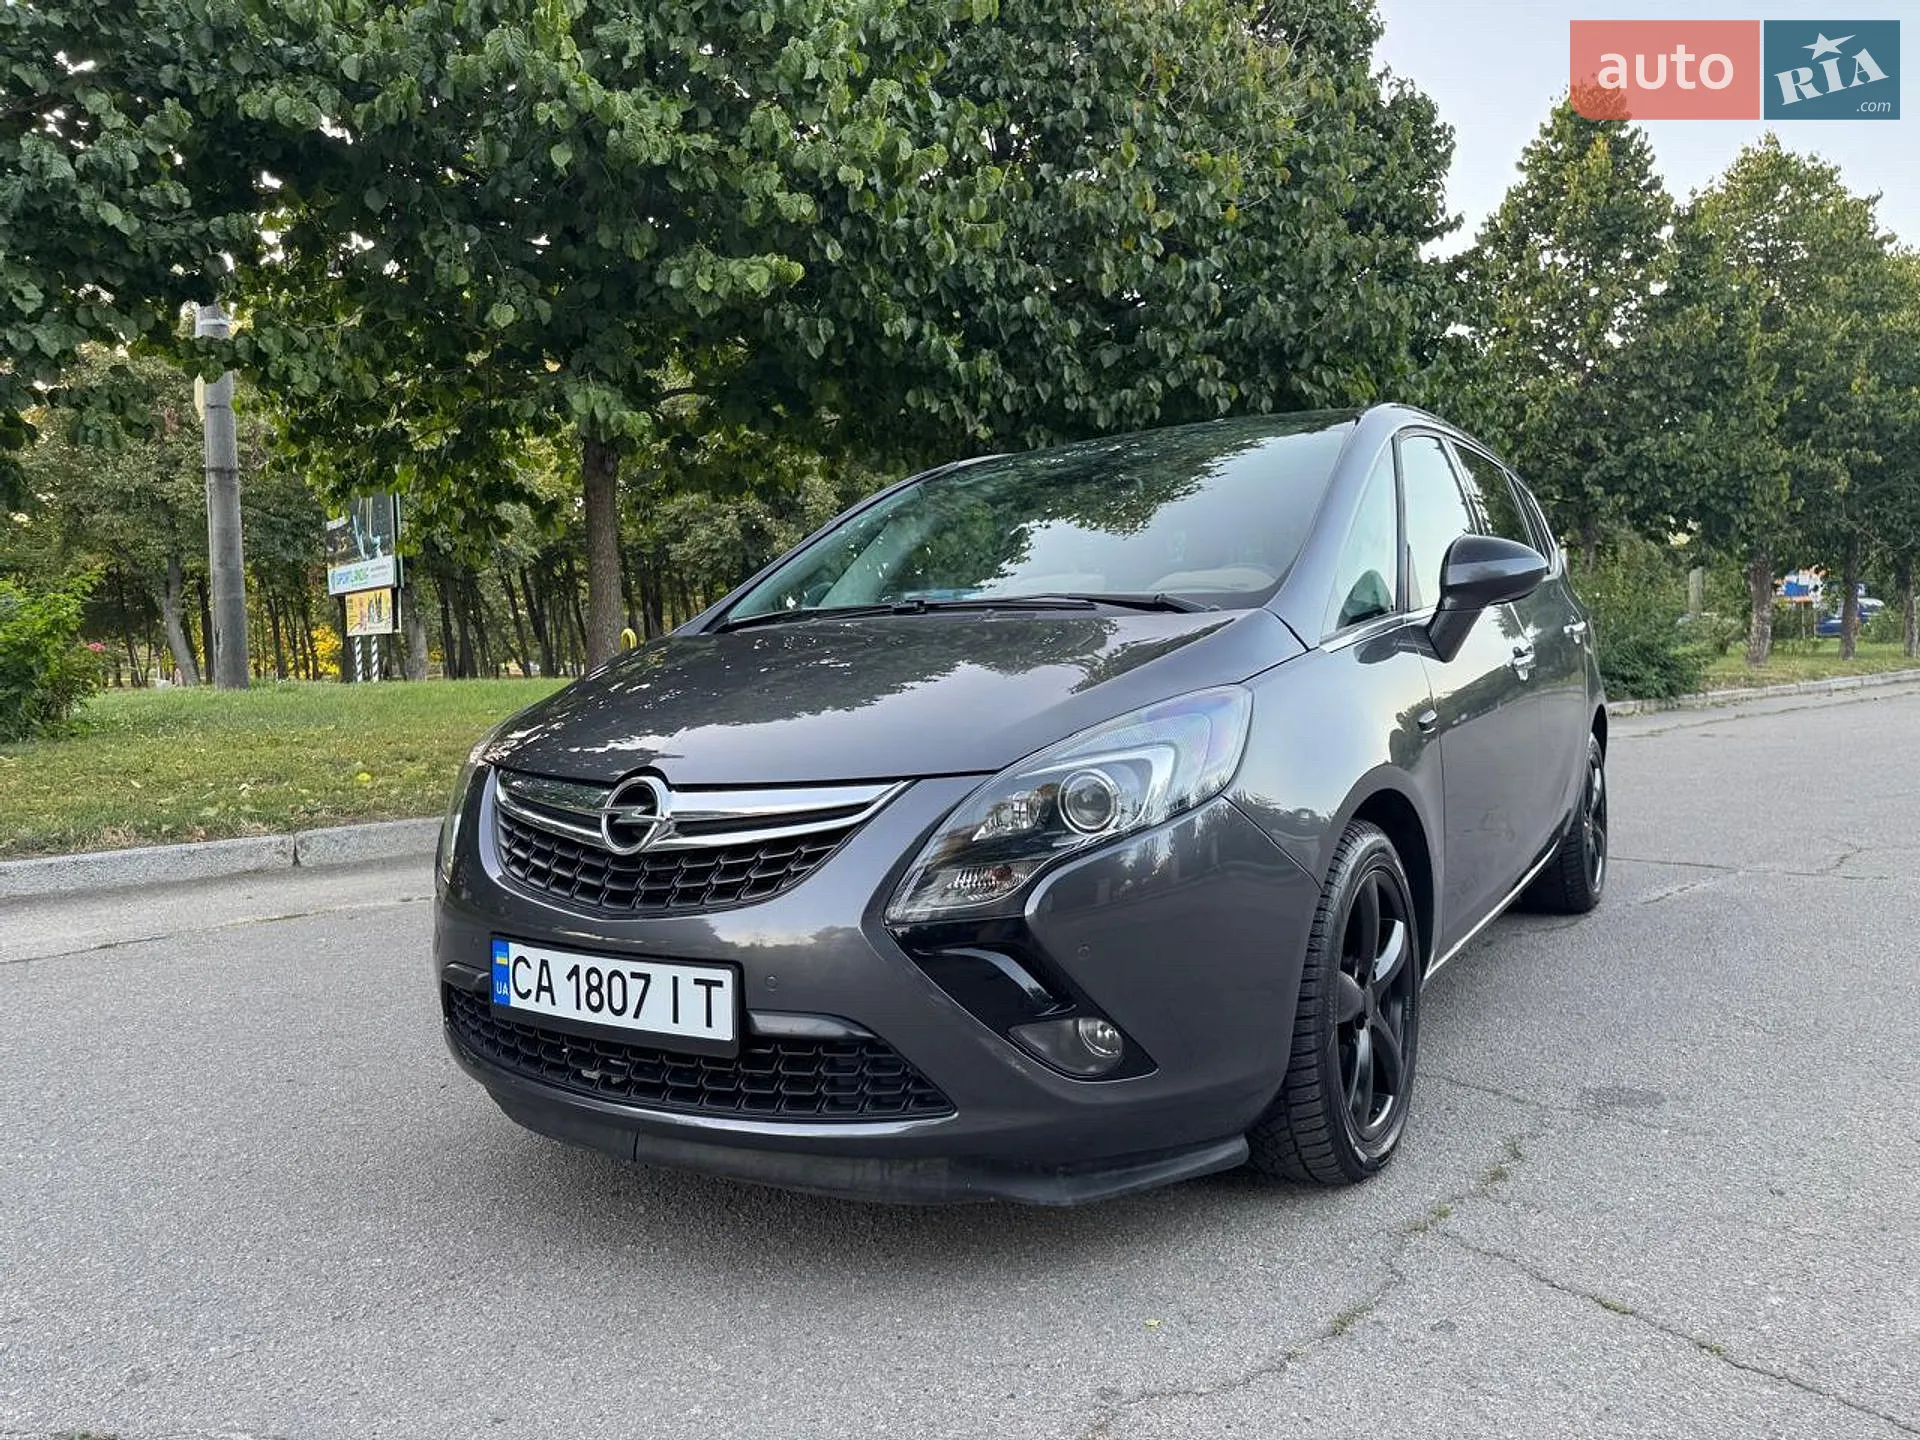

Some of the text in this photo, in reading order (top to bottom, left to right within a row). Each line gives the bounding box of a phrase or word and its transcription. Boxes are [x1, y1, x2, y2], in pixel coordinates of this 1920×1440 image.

[496, 982, 509, 996] UA
[511, 955, 724, 1028] CA 1807 IT
